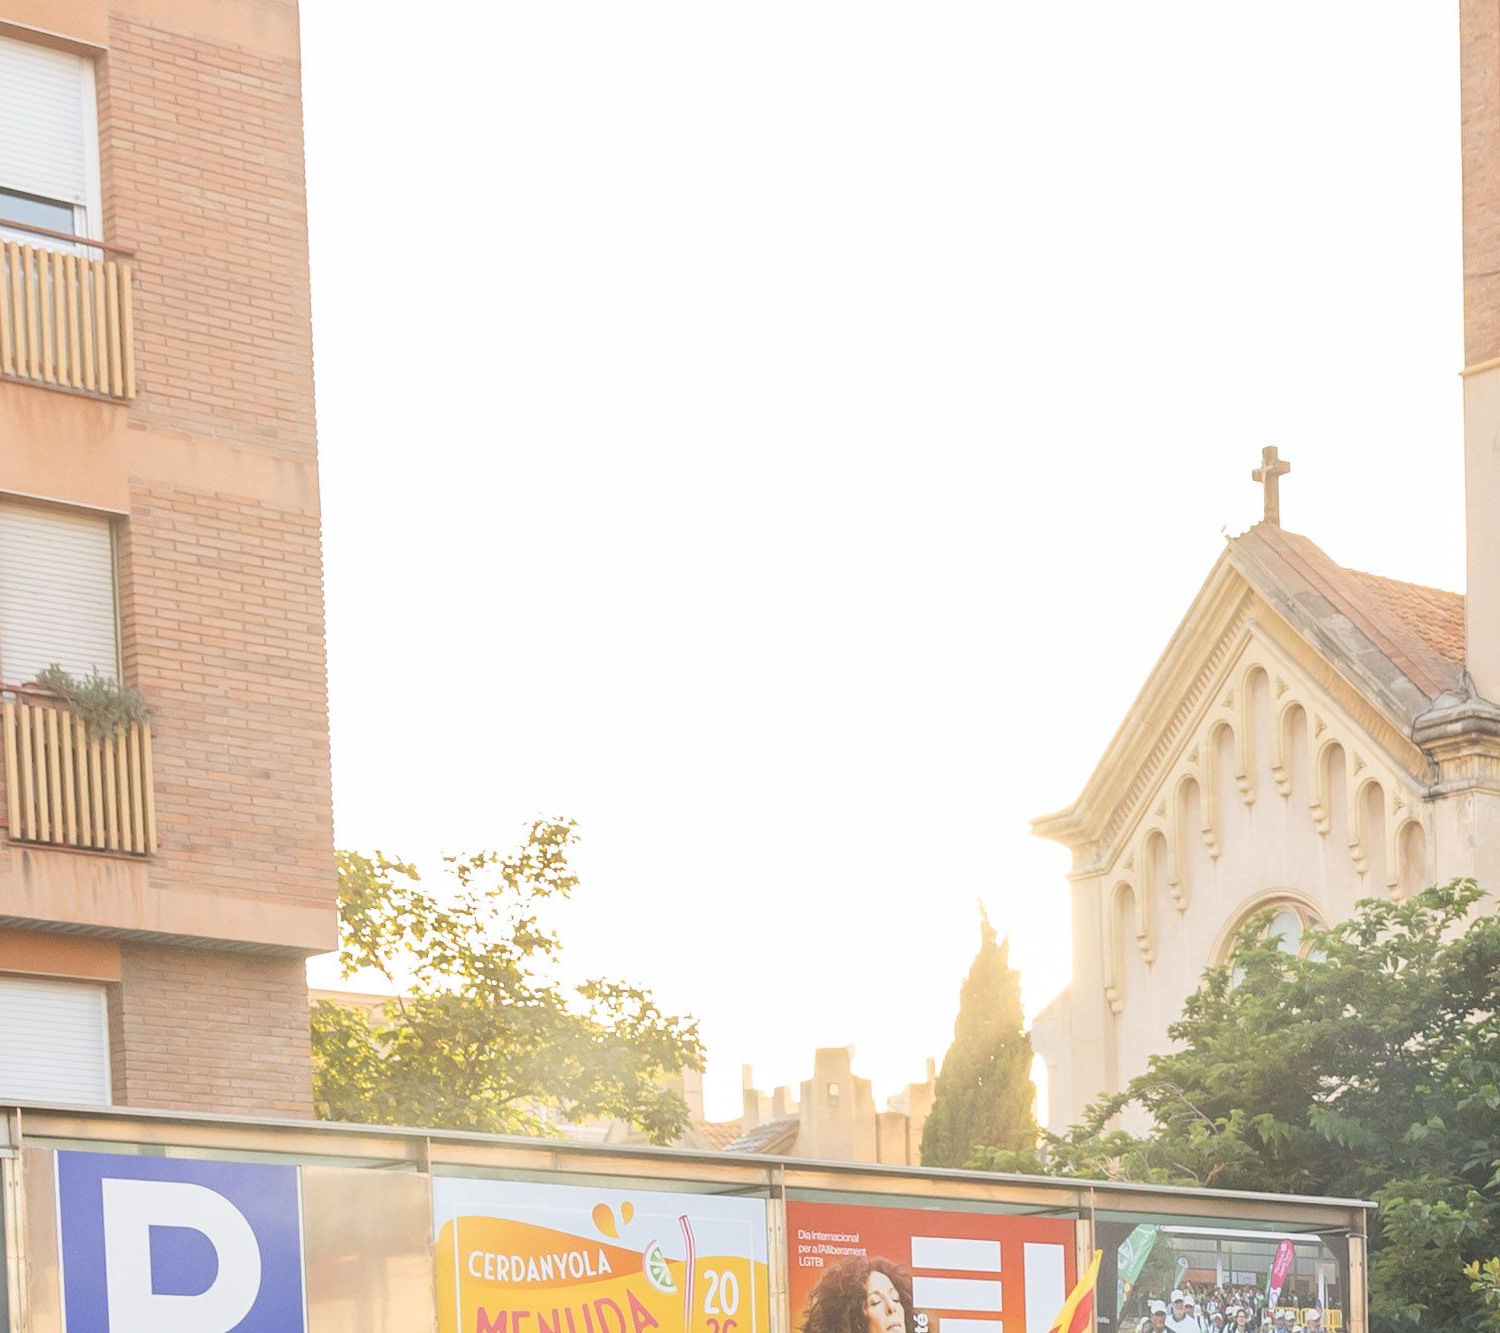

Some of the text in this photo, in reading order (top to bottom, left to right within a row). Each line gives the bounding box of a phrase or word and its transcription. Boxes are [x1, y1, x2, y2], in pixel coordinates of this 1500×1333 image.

[468, 1249, 612, 1282] CERDANYOLA
[799, 1256, 823, 1267] LGTBI
[704, 1270, 739, 1315] 20
[914, 1313, 928, 1332] té
